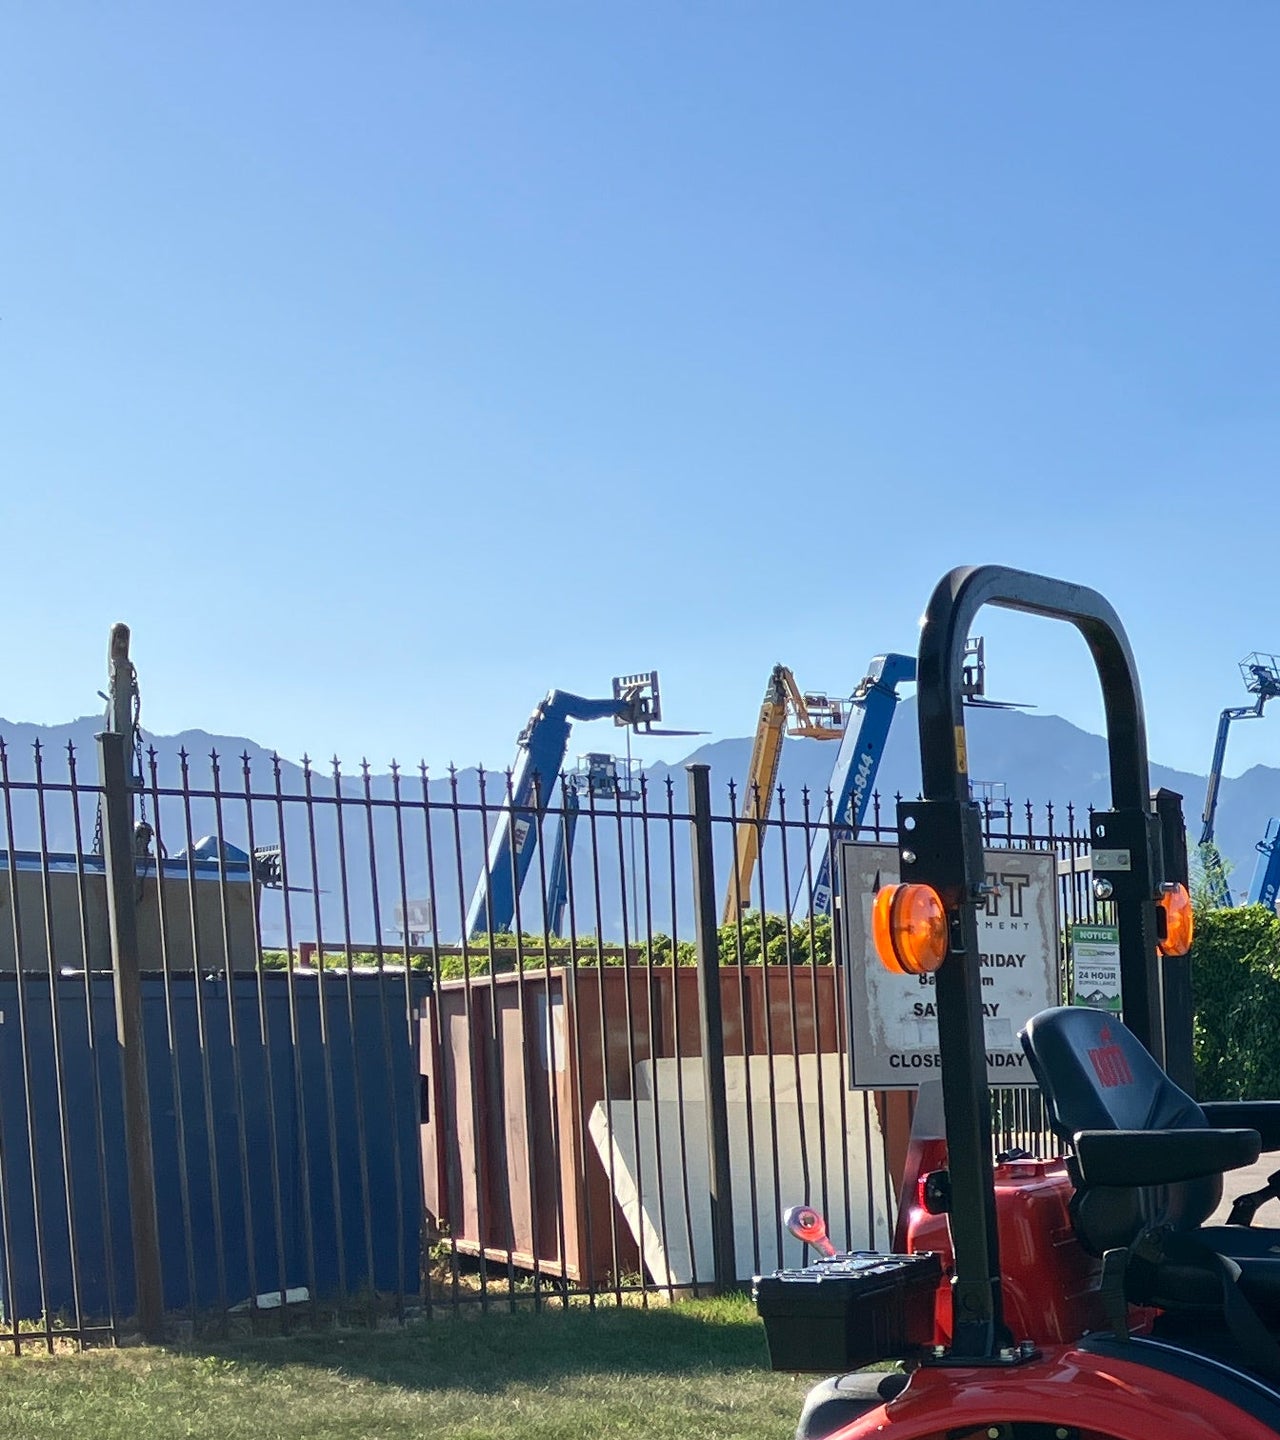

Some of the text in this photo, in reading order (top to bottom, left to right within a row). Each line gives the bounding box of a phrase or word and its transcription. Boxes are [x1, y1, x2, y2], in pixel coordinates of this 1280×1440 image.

[1079, 931, 1113, 940] NOTICE
[979, 953, 1026, 968] RIDAY
[1078, 971, 1117, 980] 24 HOUR
[889, 1054, 941, 1068] CLOSE
